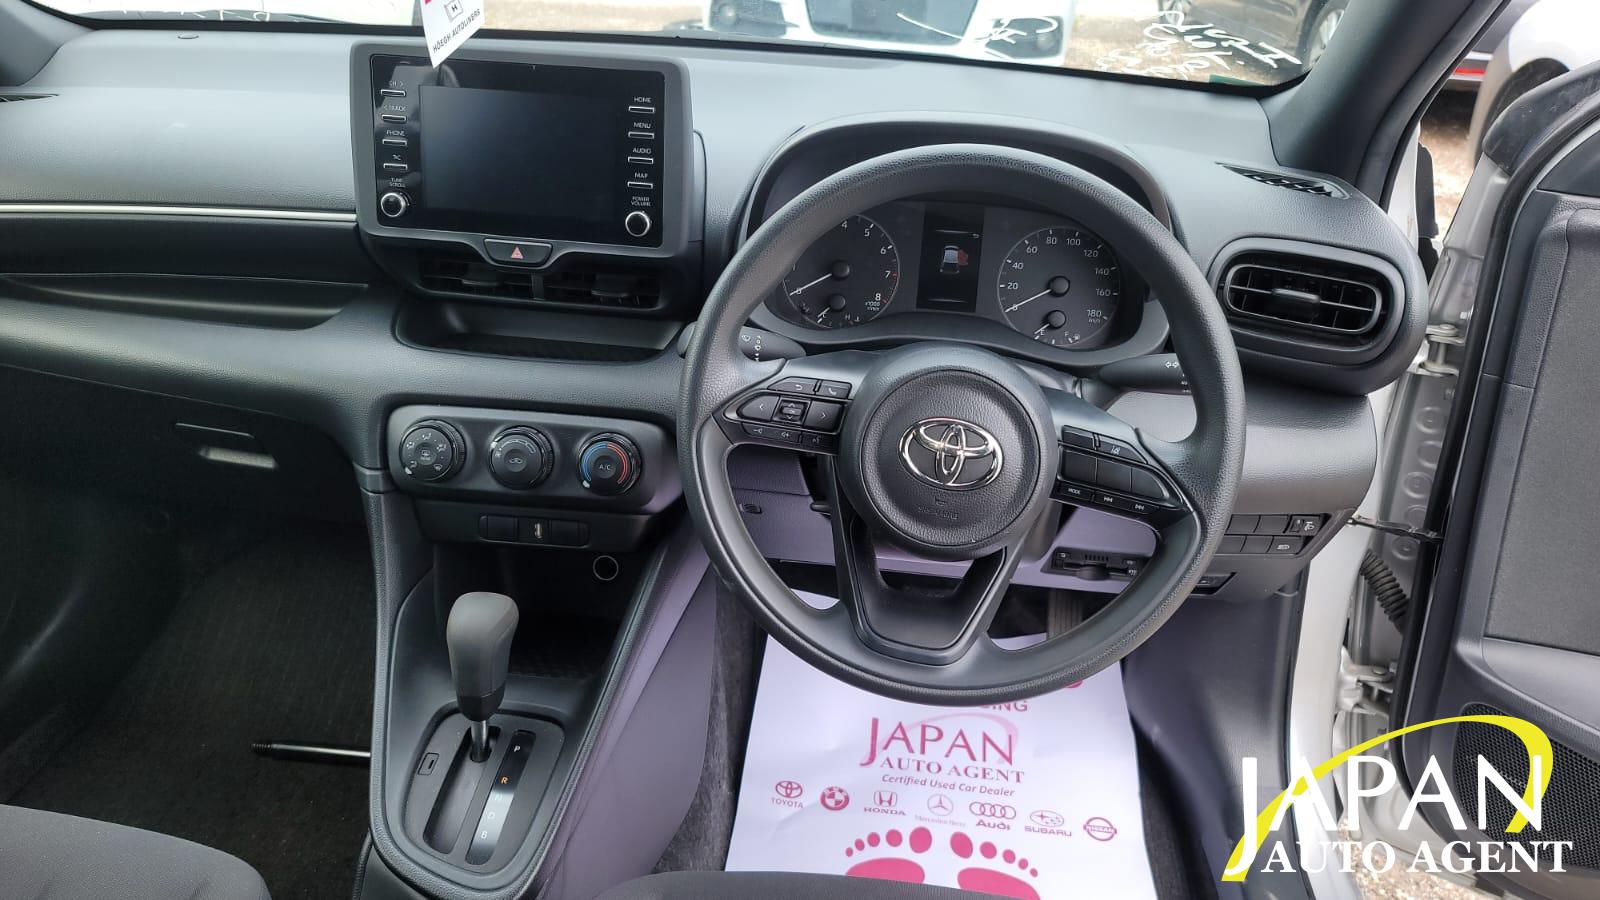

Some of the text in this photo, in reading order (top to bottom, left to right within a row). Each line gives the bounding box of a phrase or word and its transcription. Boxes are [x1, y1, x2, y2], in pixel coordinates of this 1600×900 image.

[386, 129, 405, 137] PHONE
[841, 221, 848, 229] 4
[864, 228, 870, 237] 5
[1046, 236, 1057, 245] 80
[1066, 238, 1081, 246] 100
[880, 247, 887, 255] 6
[1026, 246, 1038, 254] 60
[1083, 249, 1099, 258] 120
[1012, 262, 1024, 270] 40
[885, 270, 891, 279] 7
[1095, 268, 1110, 276] 140
[1007, 282, 1019, 290] 20
[875, 293, 881, 301] 8
[1095, 288, 1111, 297] 160
[1087, 309, 1102, 317] 180
[598, 462, 612, 471] A/C
[1068, 487, 1081, 495] MODE
[859, 716, 1013, 768] JAPAN
[880, 756, 1025, 784] AUTO AGENT
[501, 776, 508, 785] R
[882, 774, 1015, 797] Certified Used Car Dealer
[771, 797, 804, 809] TOYOTA
[864, 807, 907, 817] HONDA
[975, 819, 1011, 831] Audi
[1024, 825, 1073, 837] SUBARU
